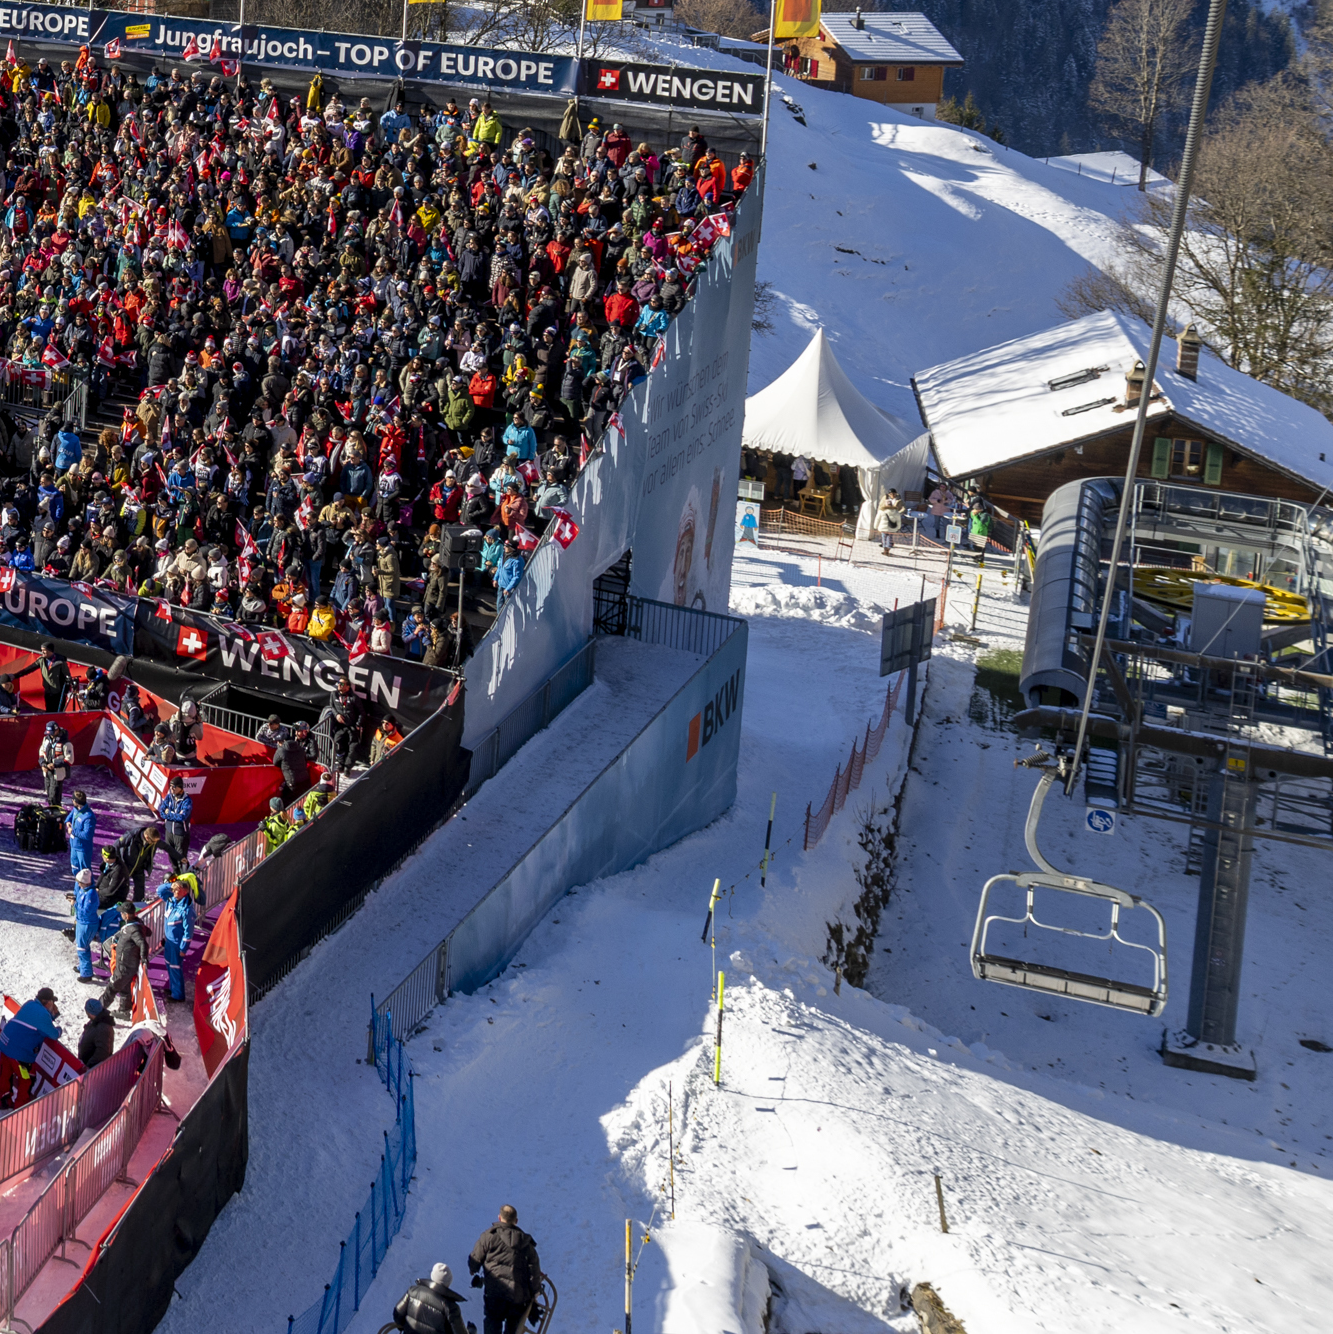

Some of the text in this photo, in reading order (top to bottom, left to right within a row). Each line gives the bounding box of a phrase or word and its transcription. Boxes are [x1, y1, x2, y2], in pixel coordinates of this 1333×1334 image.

[155, 25, 554, 85] Jungfraujoch TOP OF EUROPE
[626, 71, 754, 105] WENGEN
[737, 232, 757, 263] BKW
[647, 383, 728, 461] Team von Swiss-Ski
[650, 351, 729, 424] Wir wünschen dem
[642, 408, 735, 498] vor allem eins: Schnee.
[218, 634, 402, 709] WENGEN
[701, 667, 740, 748] BKW
